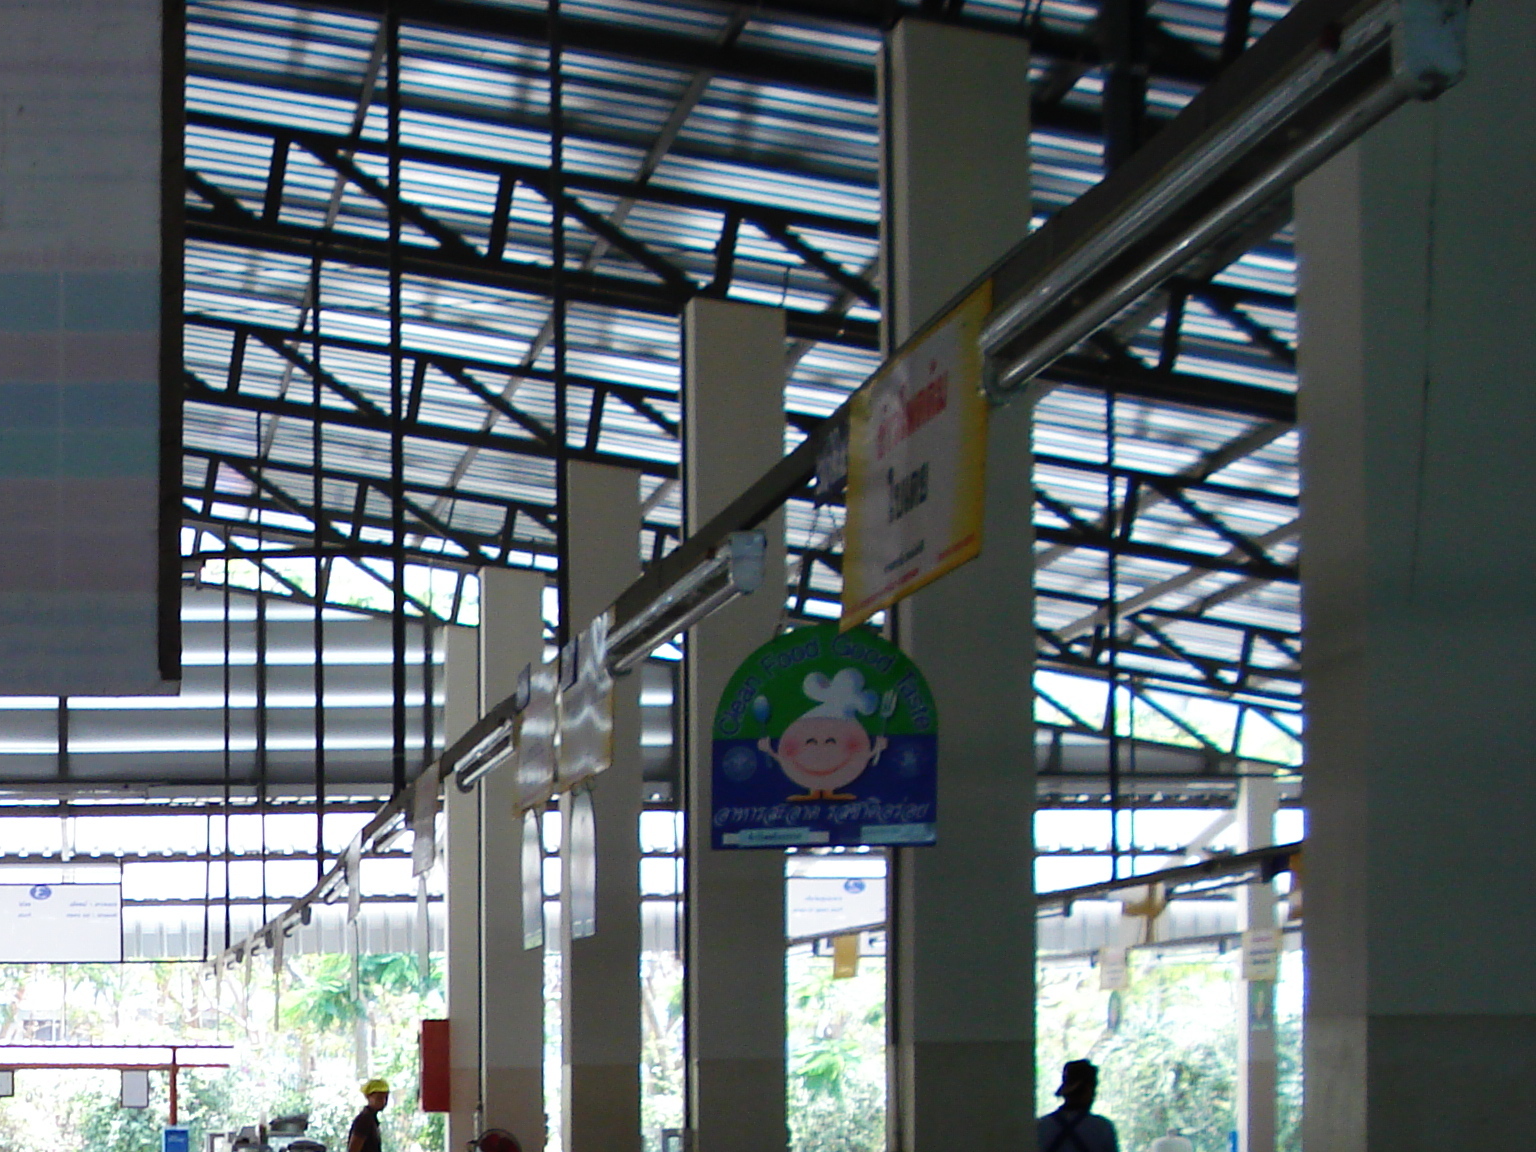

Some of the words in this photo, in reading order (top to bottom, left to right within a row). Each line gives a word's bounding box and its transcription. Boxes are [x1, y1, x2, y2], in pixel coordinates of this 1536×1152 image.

[719, 674, 760, 736] Clean
[760, 639, 820, 678] Food
[833, 634, 897, 673] Good
[896, 672, 931, 730] Taste
